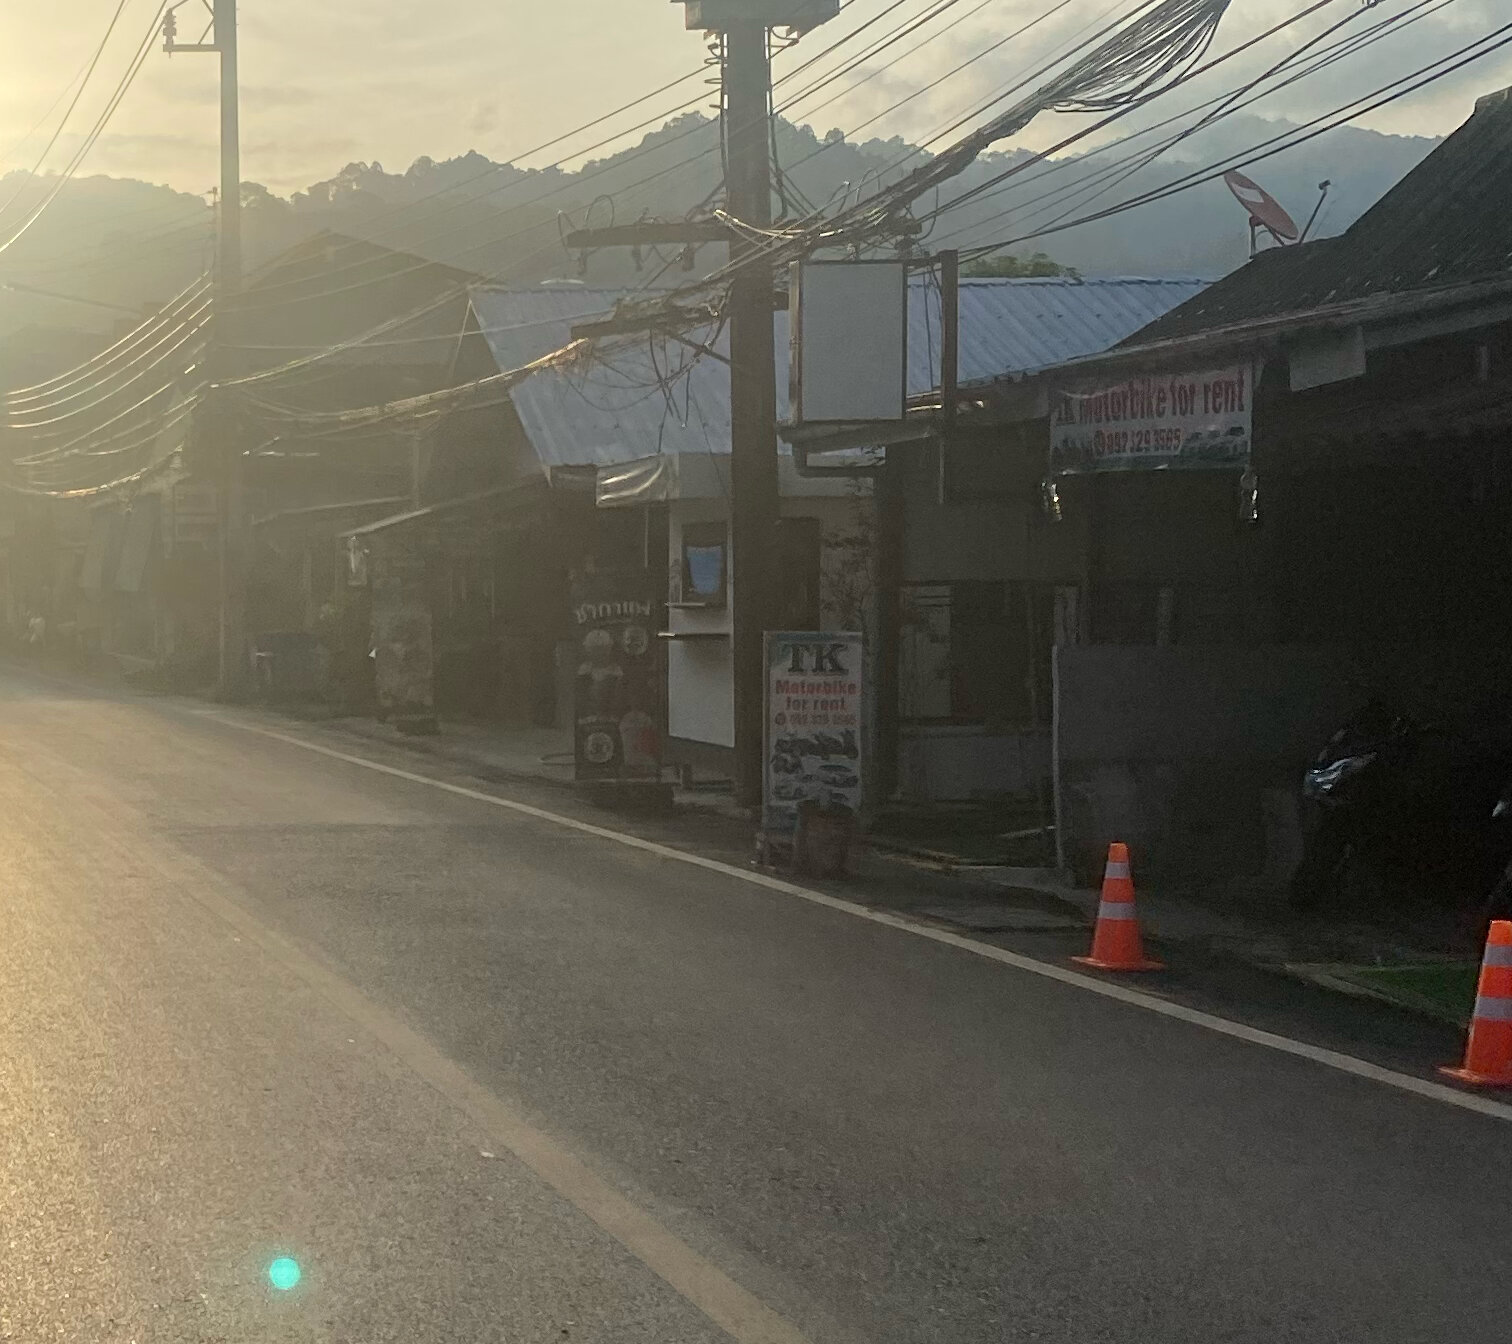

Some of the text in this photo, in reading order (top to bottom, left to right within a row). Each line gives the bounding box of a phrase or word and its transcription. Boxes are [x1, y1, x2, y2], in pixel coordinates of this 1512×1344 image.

[1169, 379, 1197, 416] for
[1203, 370, 1246, 414] rent
[783, 642, 849, 676] TK
[775, 679, 857, 695] Motorbike
[785, 696, 847, 711] for rent
